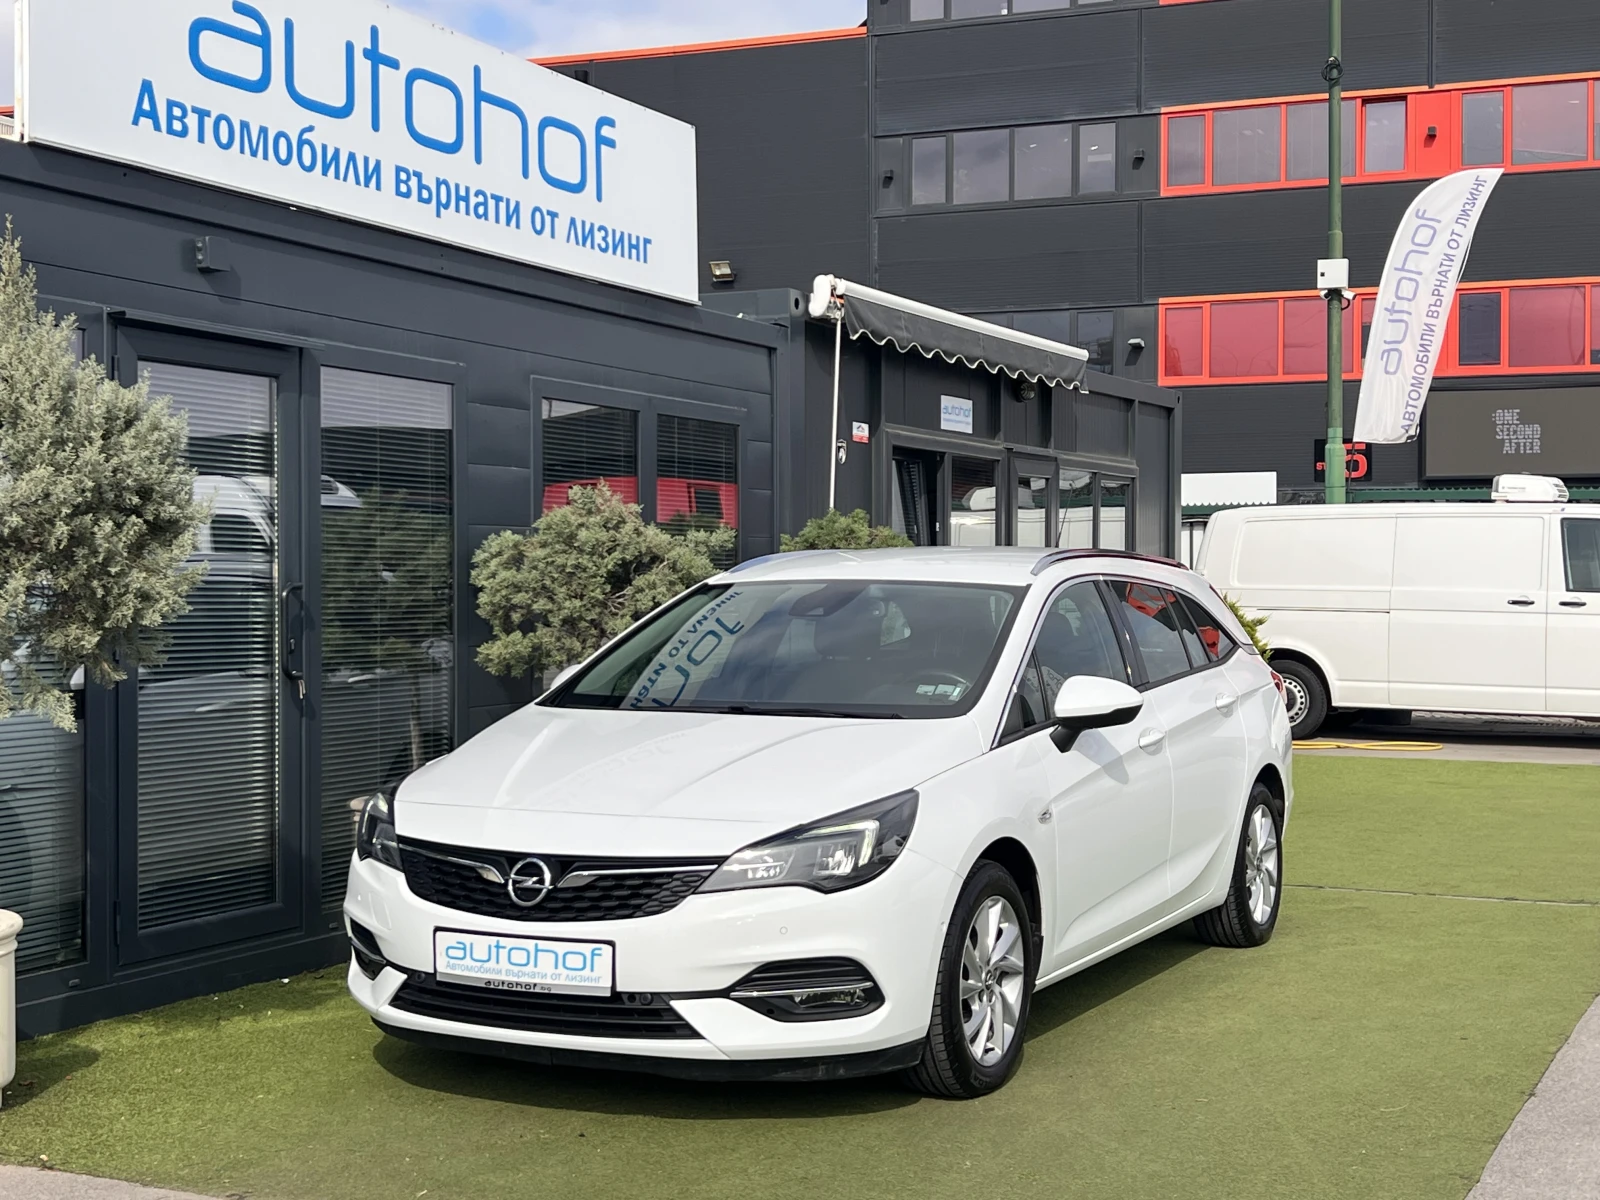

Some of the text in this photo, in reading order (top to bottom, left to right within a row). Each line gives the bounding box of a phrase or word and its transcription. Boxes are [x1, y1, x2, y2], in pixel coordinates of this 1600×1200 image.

[188, 0, 617, 203] autohof
[131, 78, 653, 264] Автомобили върнати от лизинг
[1380, 207, 1442, 376] autohof
[1400, 175, 1488, 434] АВТОМОБИЛИ ВЪРНАТИ ОТ ЛИЗИНГ
[1496, 424, 1541, 439] SECOND
[1503, 439, 1541, 454] AFTER
[445, 960, 603, 984] Автомобили върнати от лизинг
[446, 939, 603, 973] autohof
